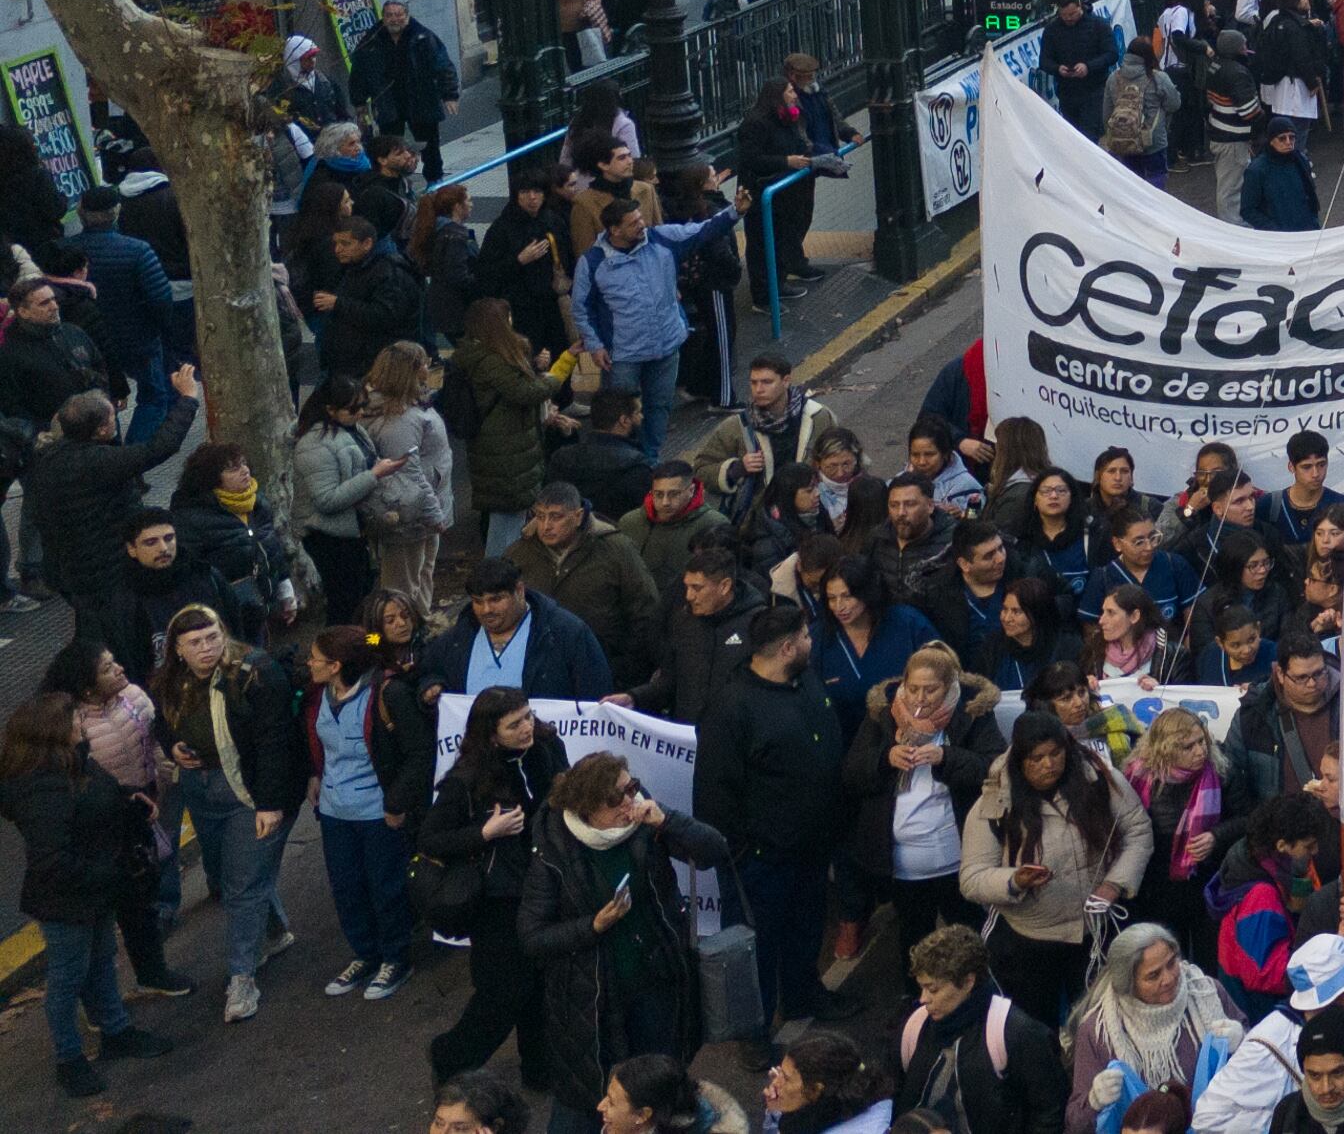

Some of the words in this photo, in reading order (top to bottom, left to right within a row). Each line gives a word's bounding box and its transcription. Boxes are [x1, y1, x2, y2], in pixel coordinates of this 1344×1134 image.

[990, 0, 1024, 11] Estado
[985, 15, 1000, 29] A
[1005, 15, 1021, 29] B
[9, 58, 54, 91] MAPLE
[1055, 353, 1152, 395] centro
[1163, 371, 1216, 402] de
[1038, 382, 1185, 440] arquitectura,
[1191, 411, 1290, 439] diseño
[1299, 416, 1314, 433] y
[549, 719, 626, 741] SUPERIOR
[631, 729, 651, 750] EN
